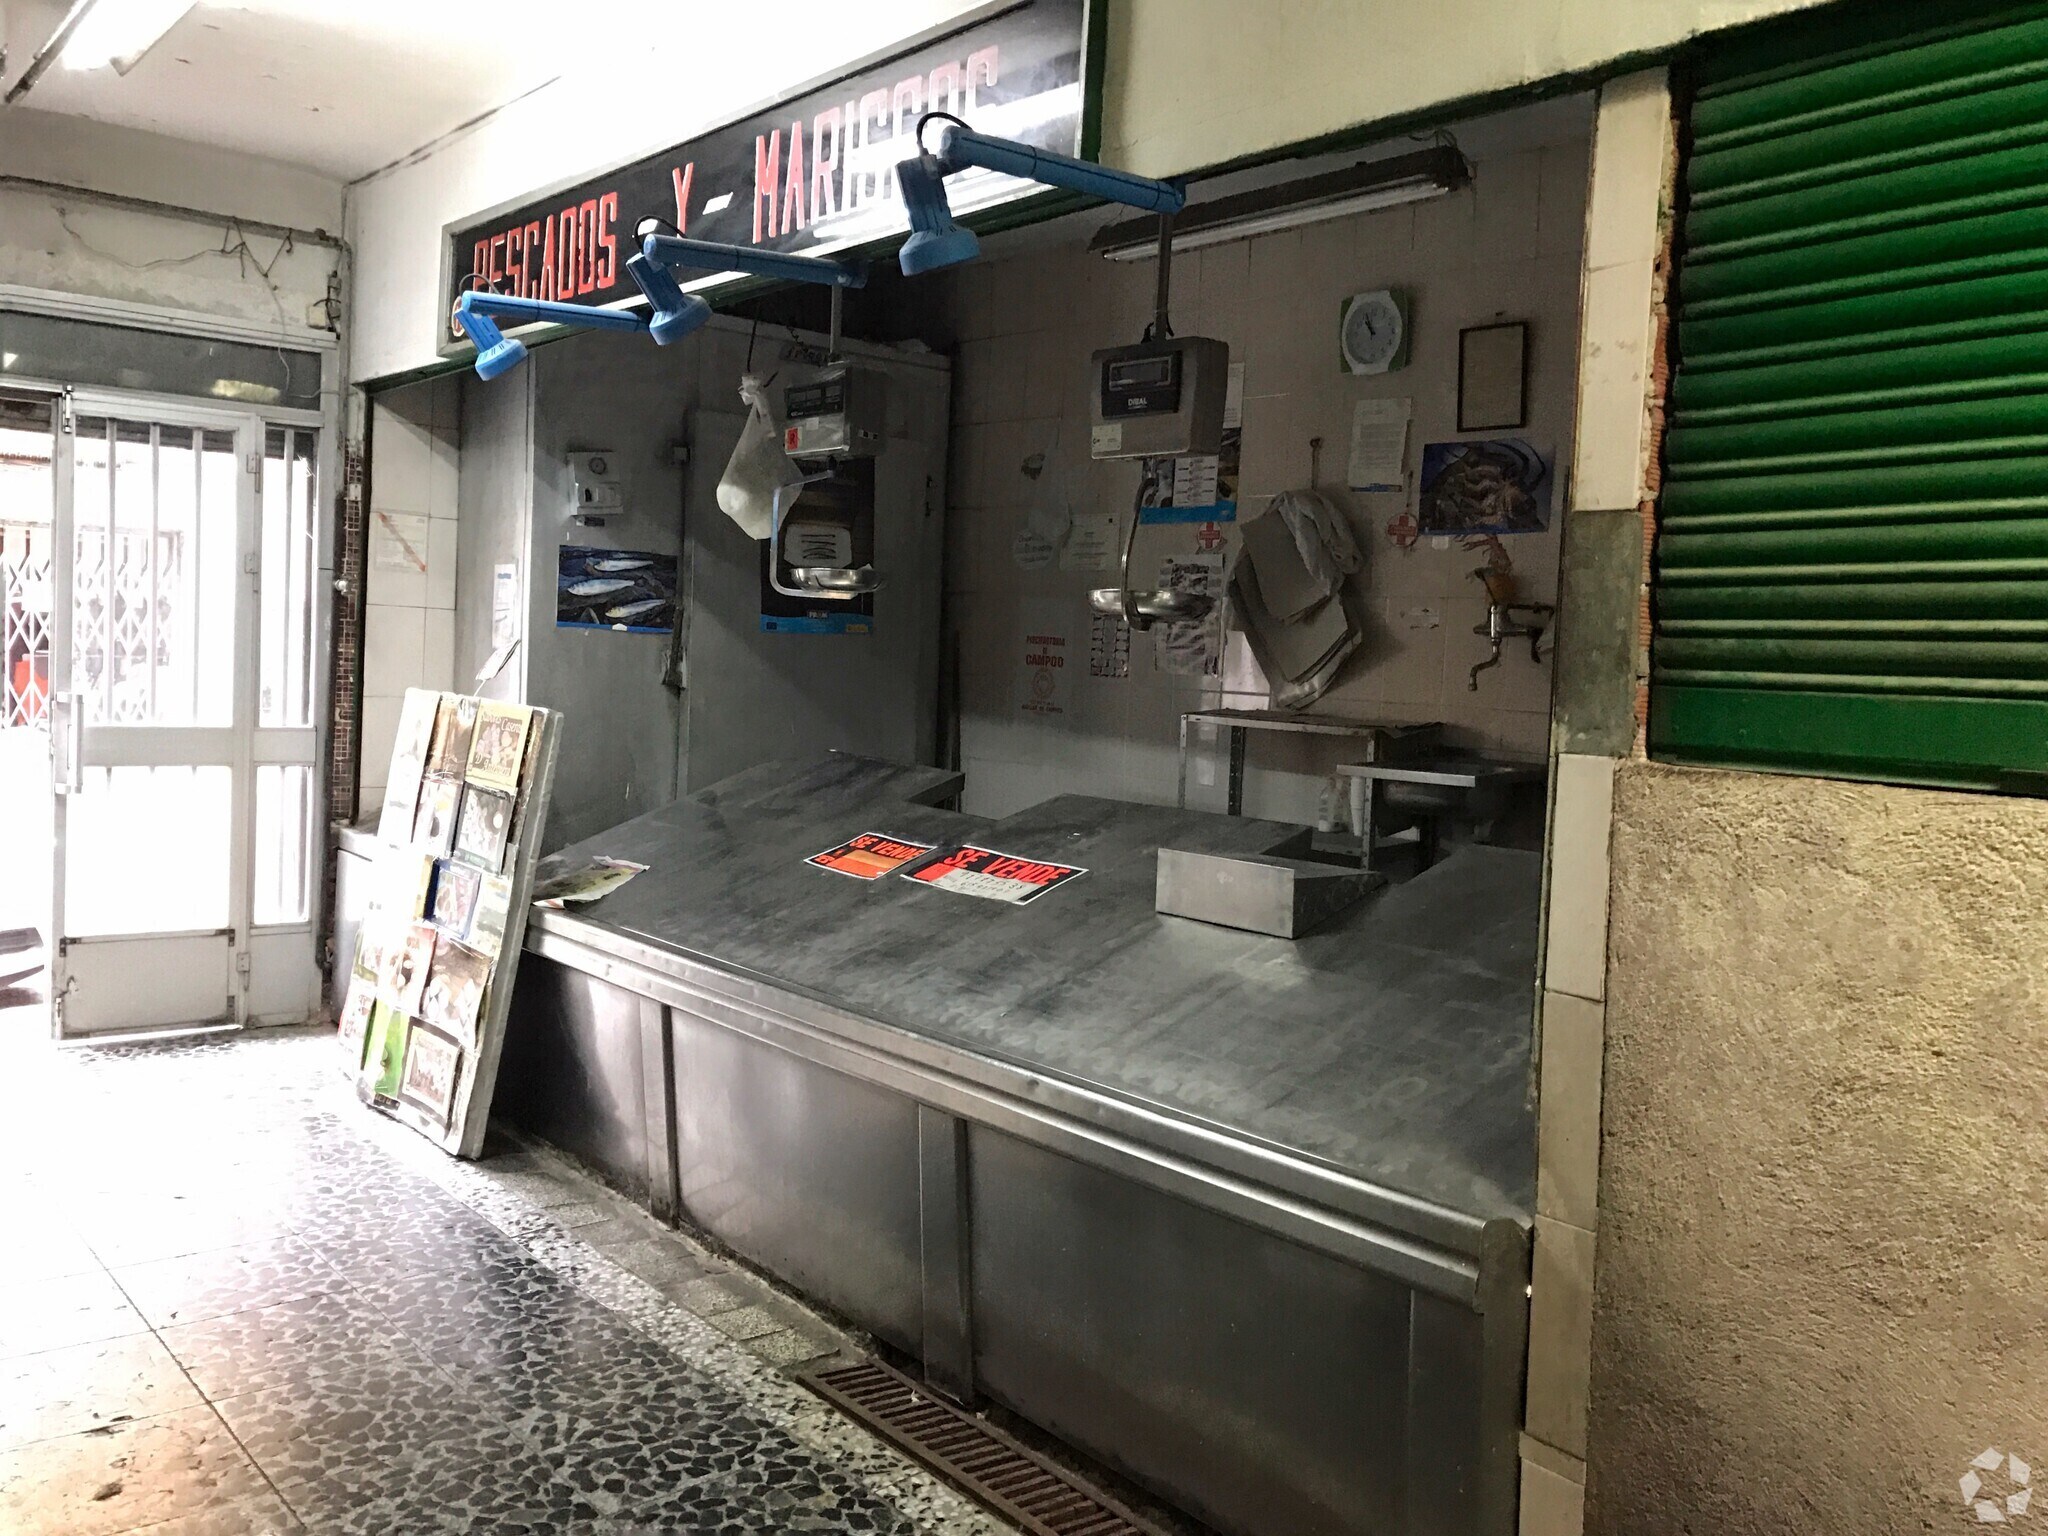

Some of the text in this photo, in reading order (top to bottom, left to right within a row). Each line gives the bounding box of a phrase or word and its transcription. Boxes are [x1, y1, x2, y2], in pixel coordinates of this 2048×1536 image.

[472, 191, 618, 301] PESCADOS
[672, 162, 694, 239] Y
[1025, 654, 1065, 669] CAMPOO
[849, 836, 926, 861] SE VENDE
[943, 849, 990, 869] SE
[981, 857, 1072, 887] VENDE
